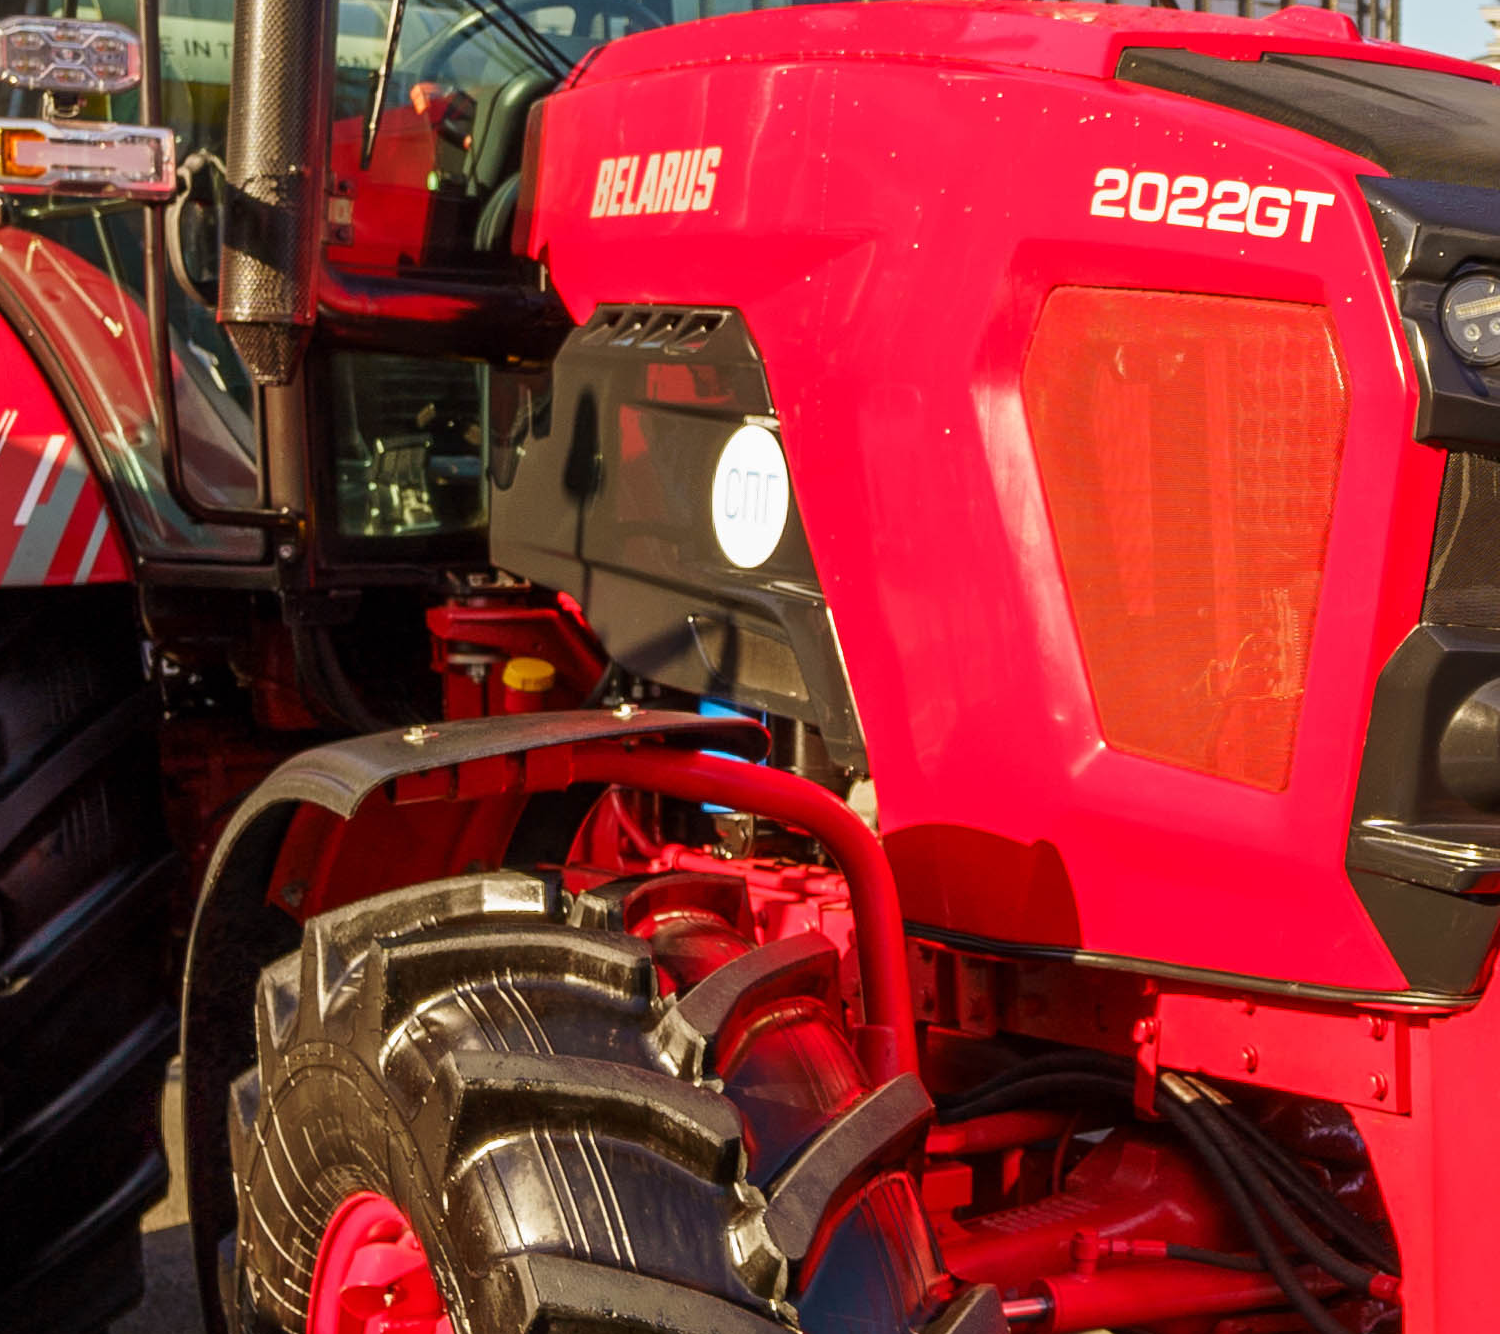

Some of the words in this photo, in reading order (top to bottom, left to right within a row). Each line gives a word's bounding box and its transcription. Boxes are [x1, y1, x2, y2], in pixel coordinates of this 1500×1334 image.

[590, 146, 722, 218] BELARUS
[1090, 167, 1336, 243] 2022GT
[725, 468, 780, 524] СПГ
